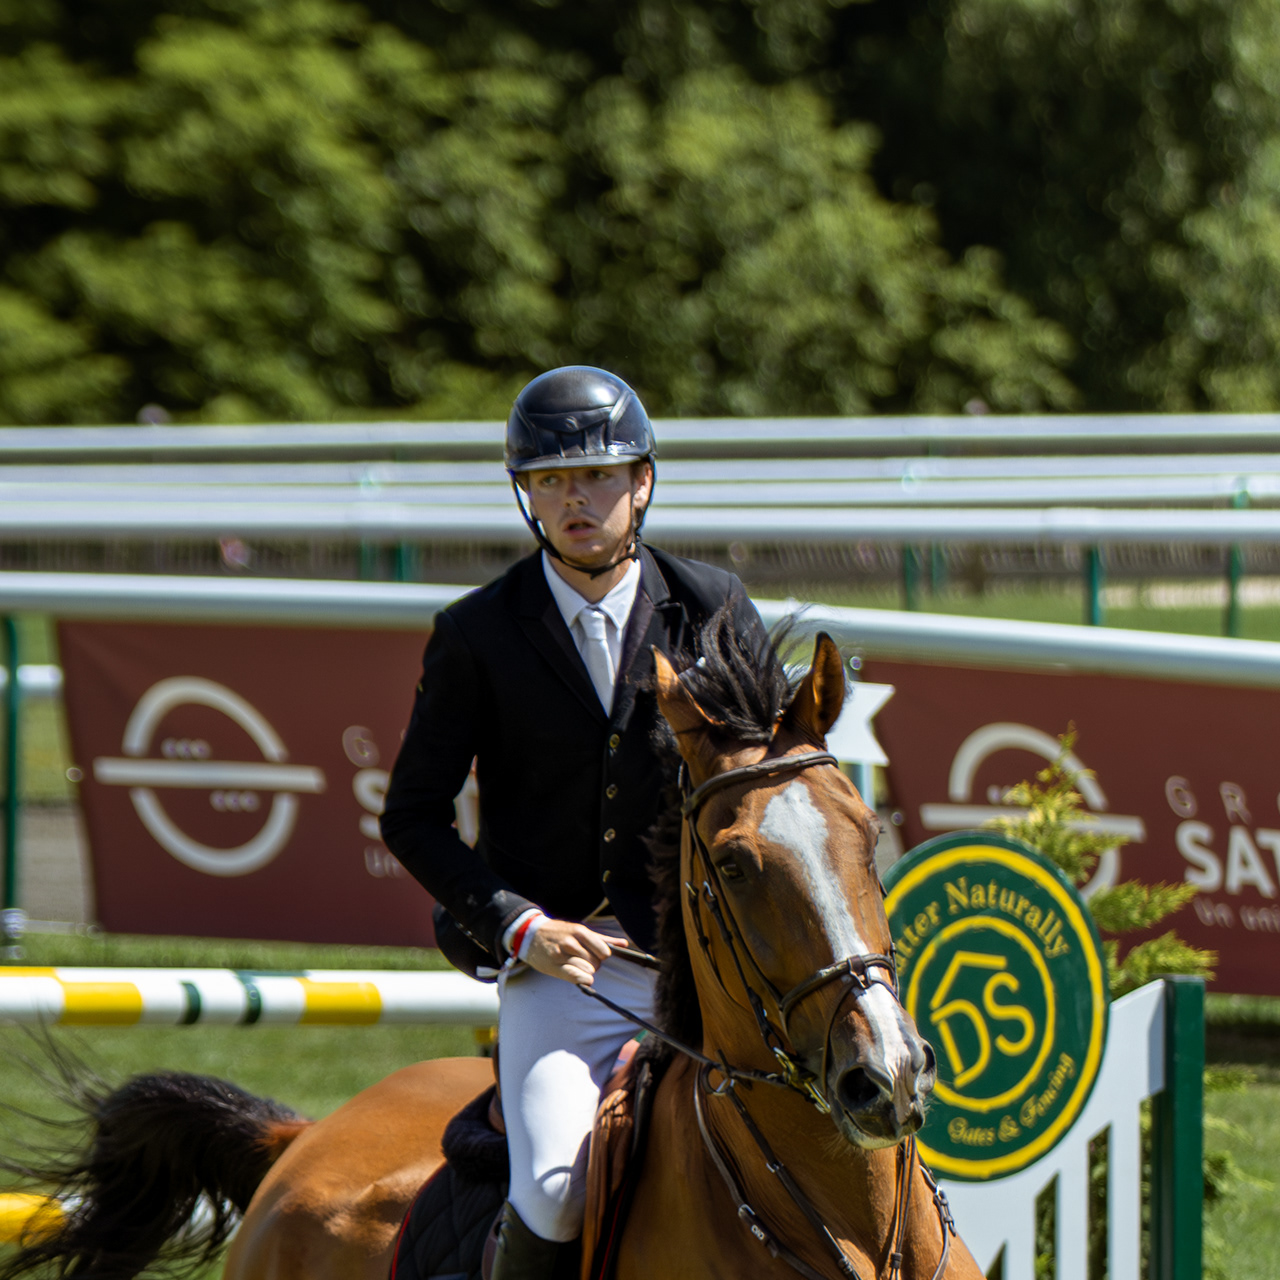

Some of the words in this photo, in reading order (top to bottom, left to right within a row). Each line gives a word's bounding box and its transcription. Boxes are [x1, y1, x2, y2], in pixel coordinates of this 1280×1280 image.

[897, 900, 941, 976] utter
[943, 876, 1070, 959] Naturally
[930, 971, 1035, 1089] DS
[947, 1116, 996, 1146] Gates
[998, 1114, 1021, 1142] &
[1020, 1052, 1075, 1128] Fencing
